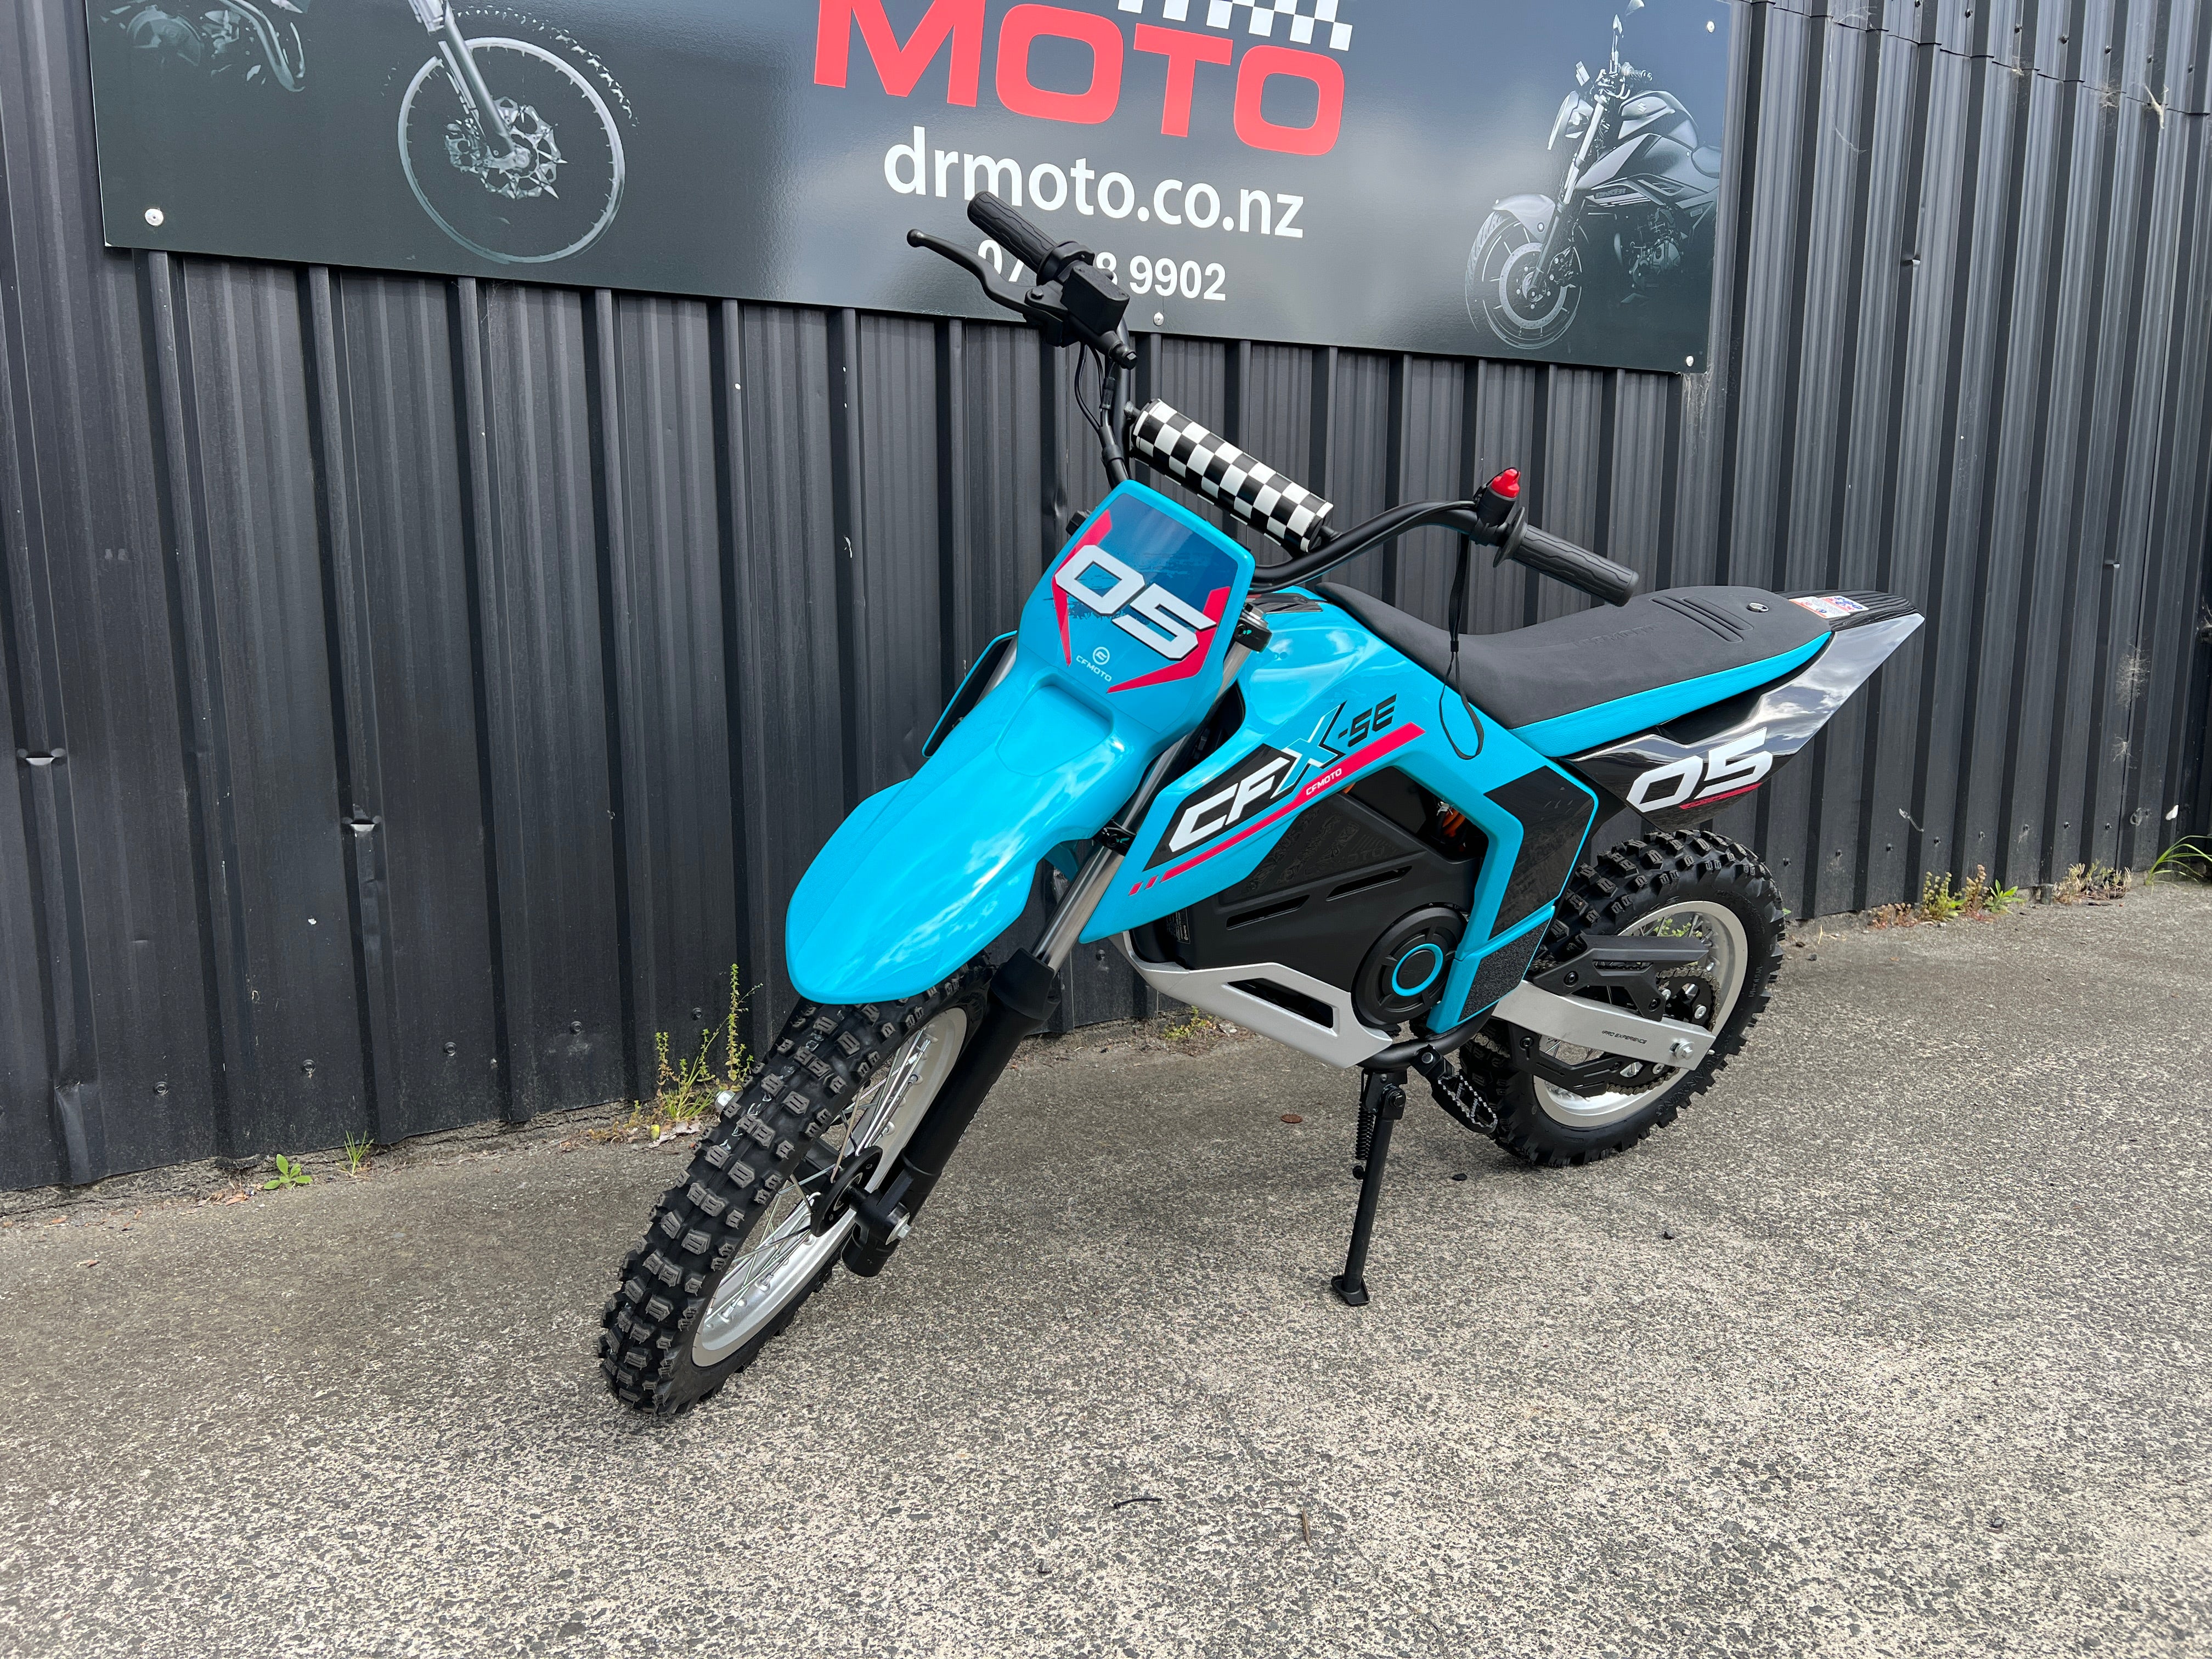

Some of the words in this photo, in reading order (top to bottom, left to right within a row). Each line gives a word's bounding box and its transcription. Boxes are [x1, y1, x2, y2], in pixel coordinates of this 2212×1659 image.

[814, 0, 1345, 156] MOTO
[884, 126, 1304, 238] drmoto.co.nz
[1130, 255, 1226, 301] 9902
[1054, 544, 1217, 661] 05
[1076, 654, 1112, 682] CFMOTO
[1306, 768, 1342, 796] CFMOTO
[1626, 727, 1773, 812] 05
[1615, 1033, 1647, 1044] EXPERIENCE
